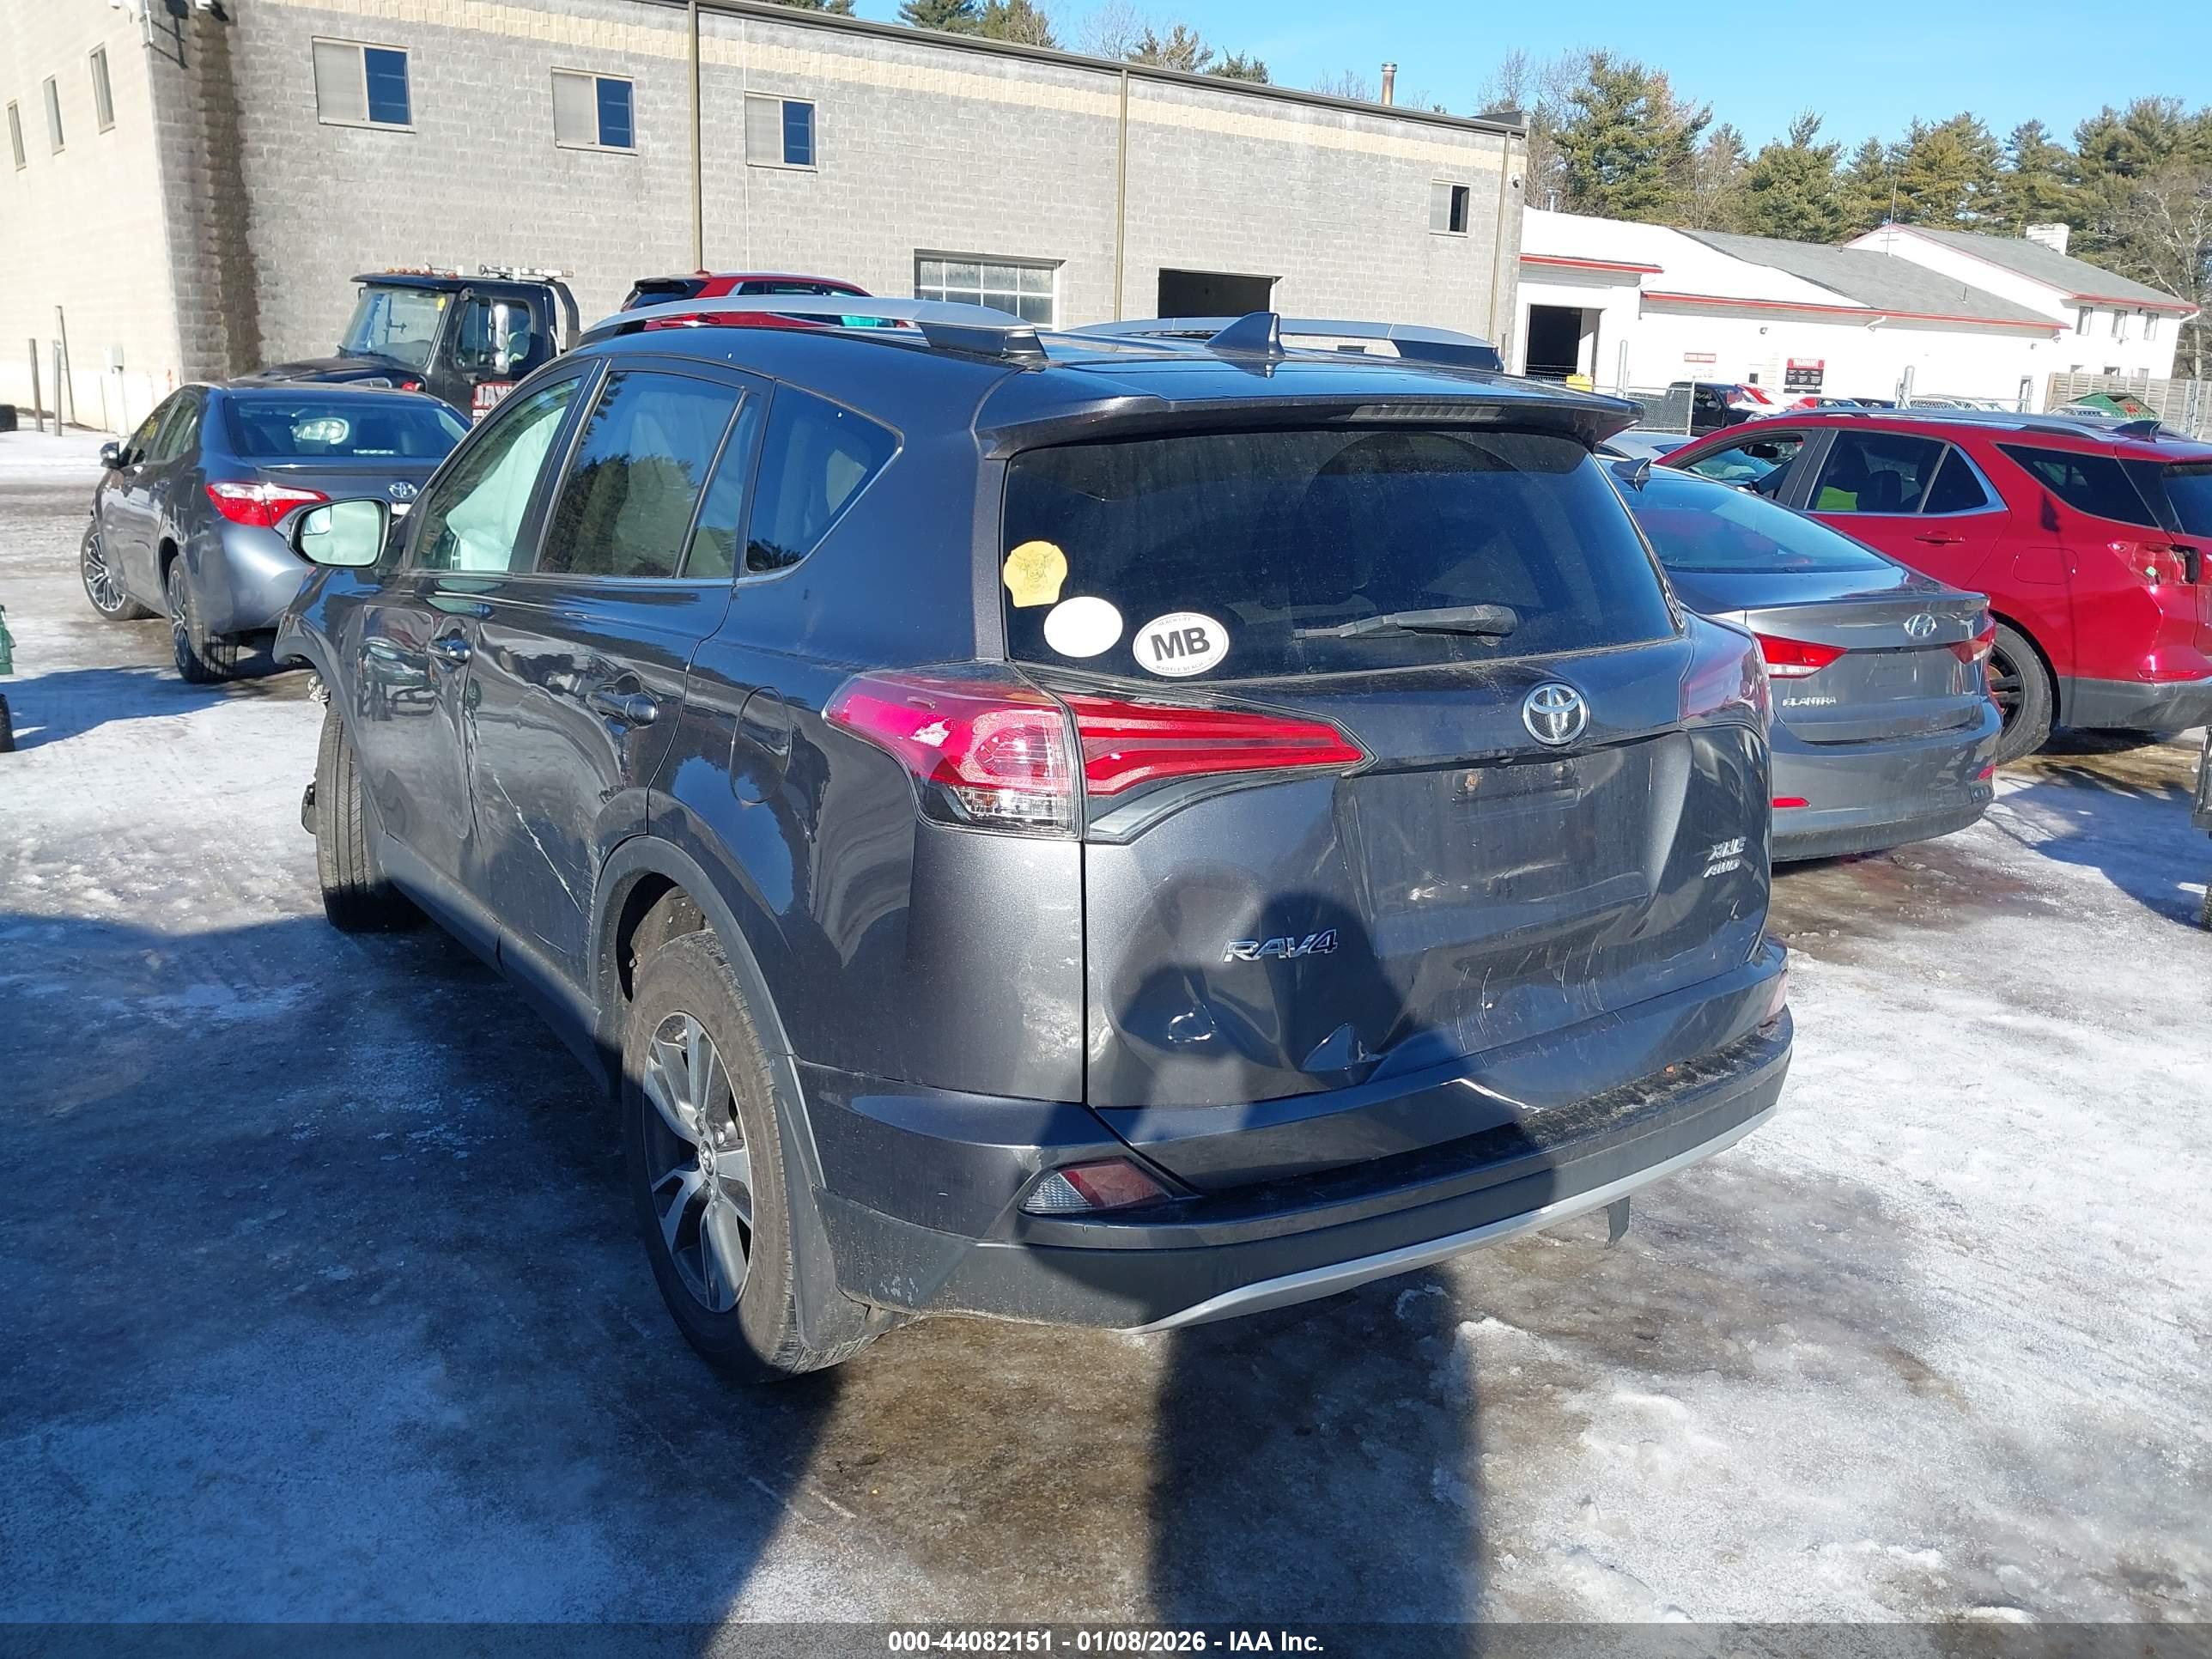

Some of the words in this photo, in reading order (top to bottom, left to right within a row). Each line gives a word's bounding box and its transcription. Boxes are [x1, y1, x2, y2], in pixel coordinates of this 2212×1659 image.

[1151, 628, 1210, 661] MB
[1782, 696, 1837, 707] ELANTRA
[1707, 836, 1747, 861] XLE
[1703, 859, 1741, 878] AWD
[1220, 928, 1338, 963] RAV4
